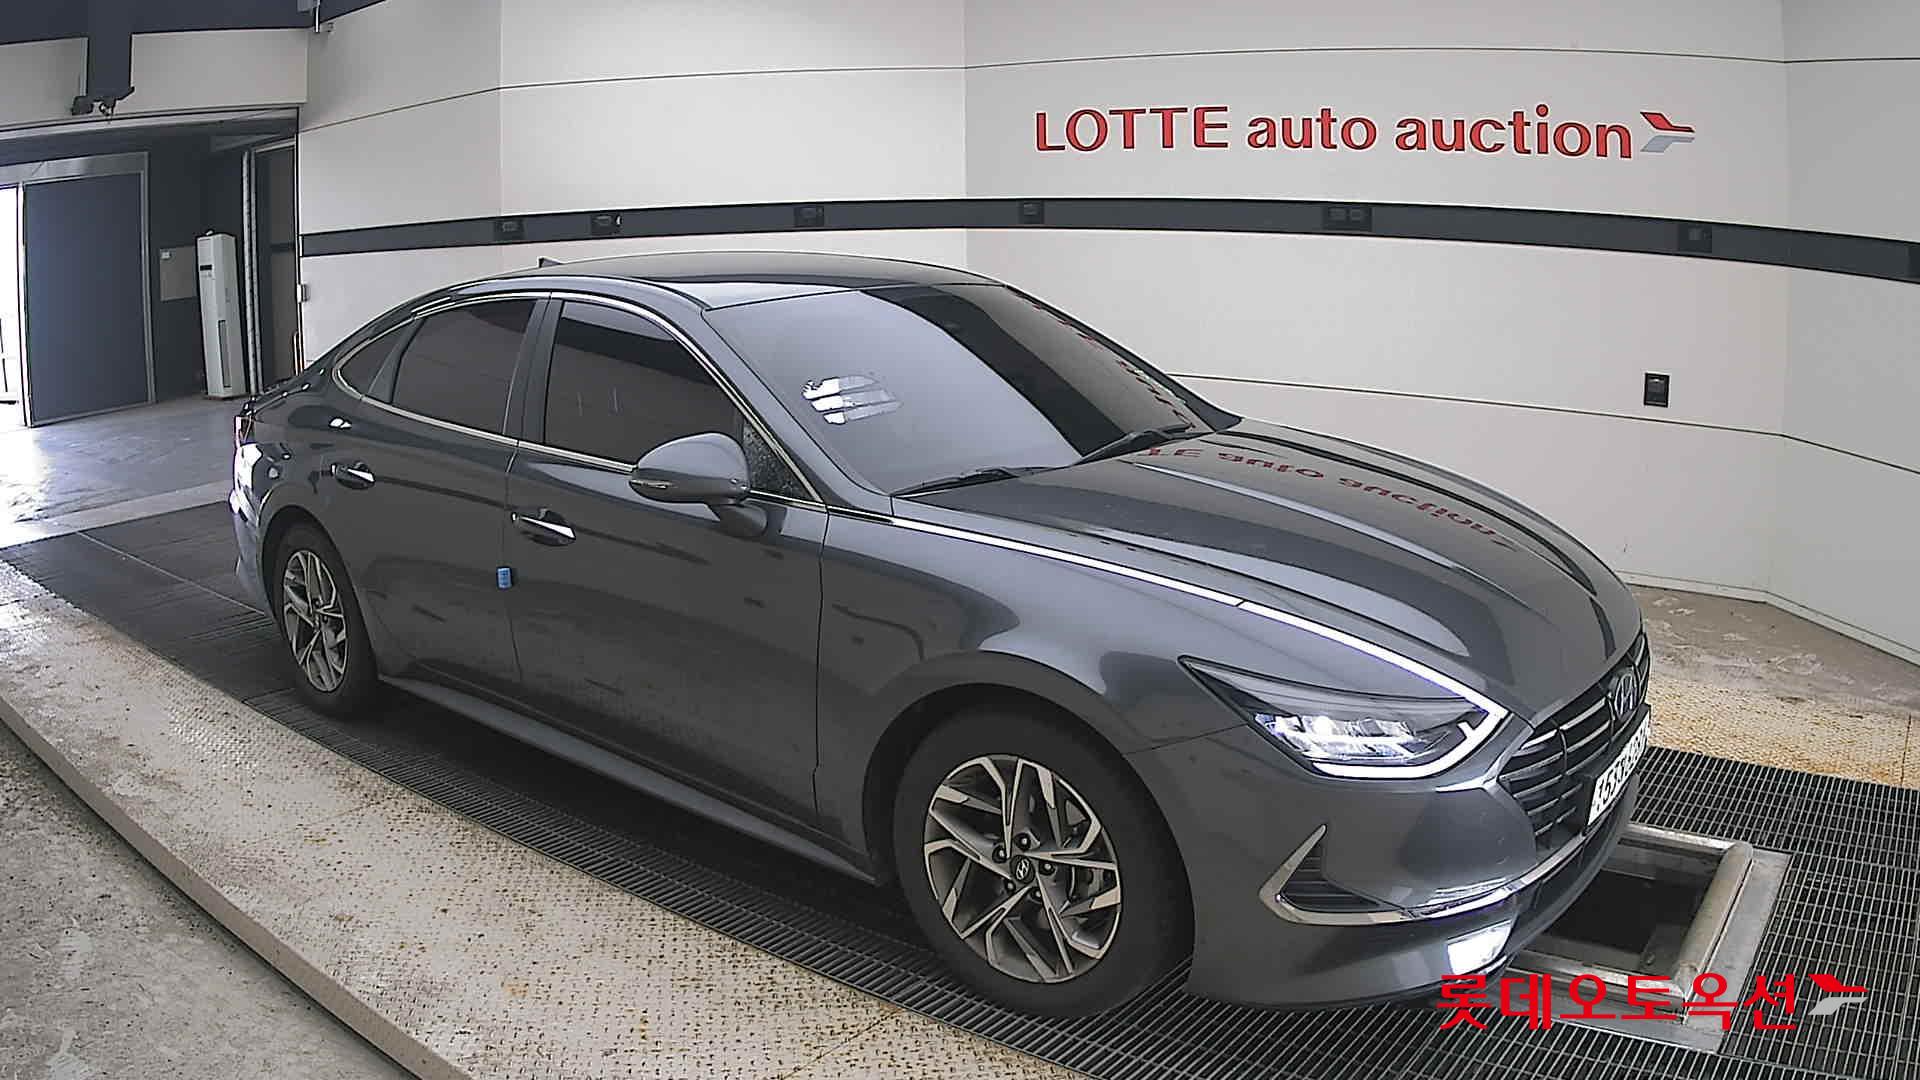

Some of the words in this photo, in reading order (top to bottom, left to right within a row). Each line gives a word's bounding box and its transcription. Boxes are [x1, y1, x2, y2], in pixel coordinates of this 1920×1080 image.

[1036, 105, 1229, 152] LOTTE
[1247, 107, 1378, 152] auto
[1395, 103, 1633, 159] auction
